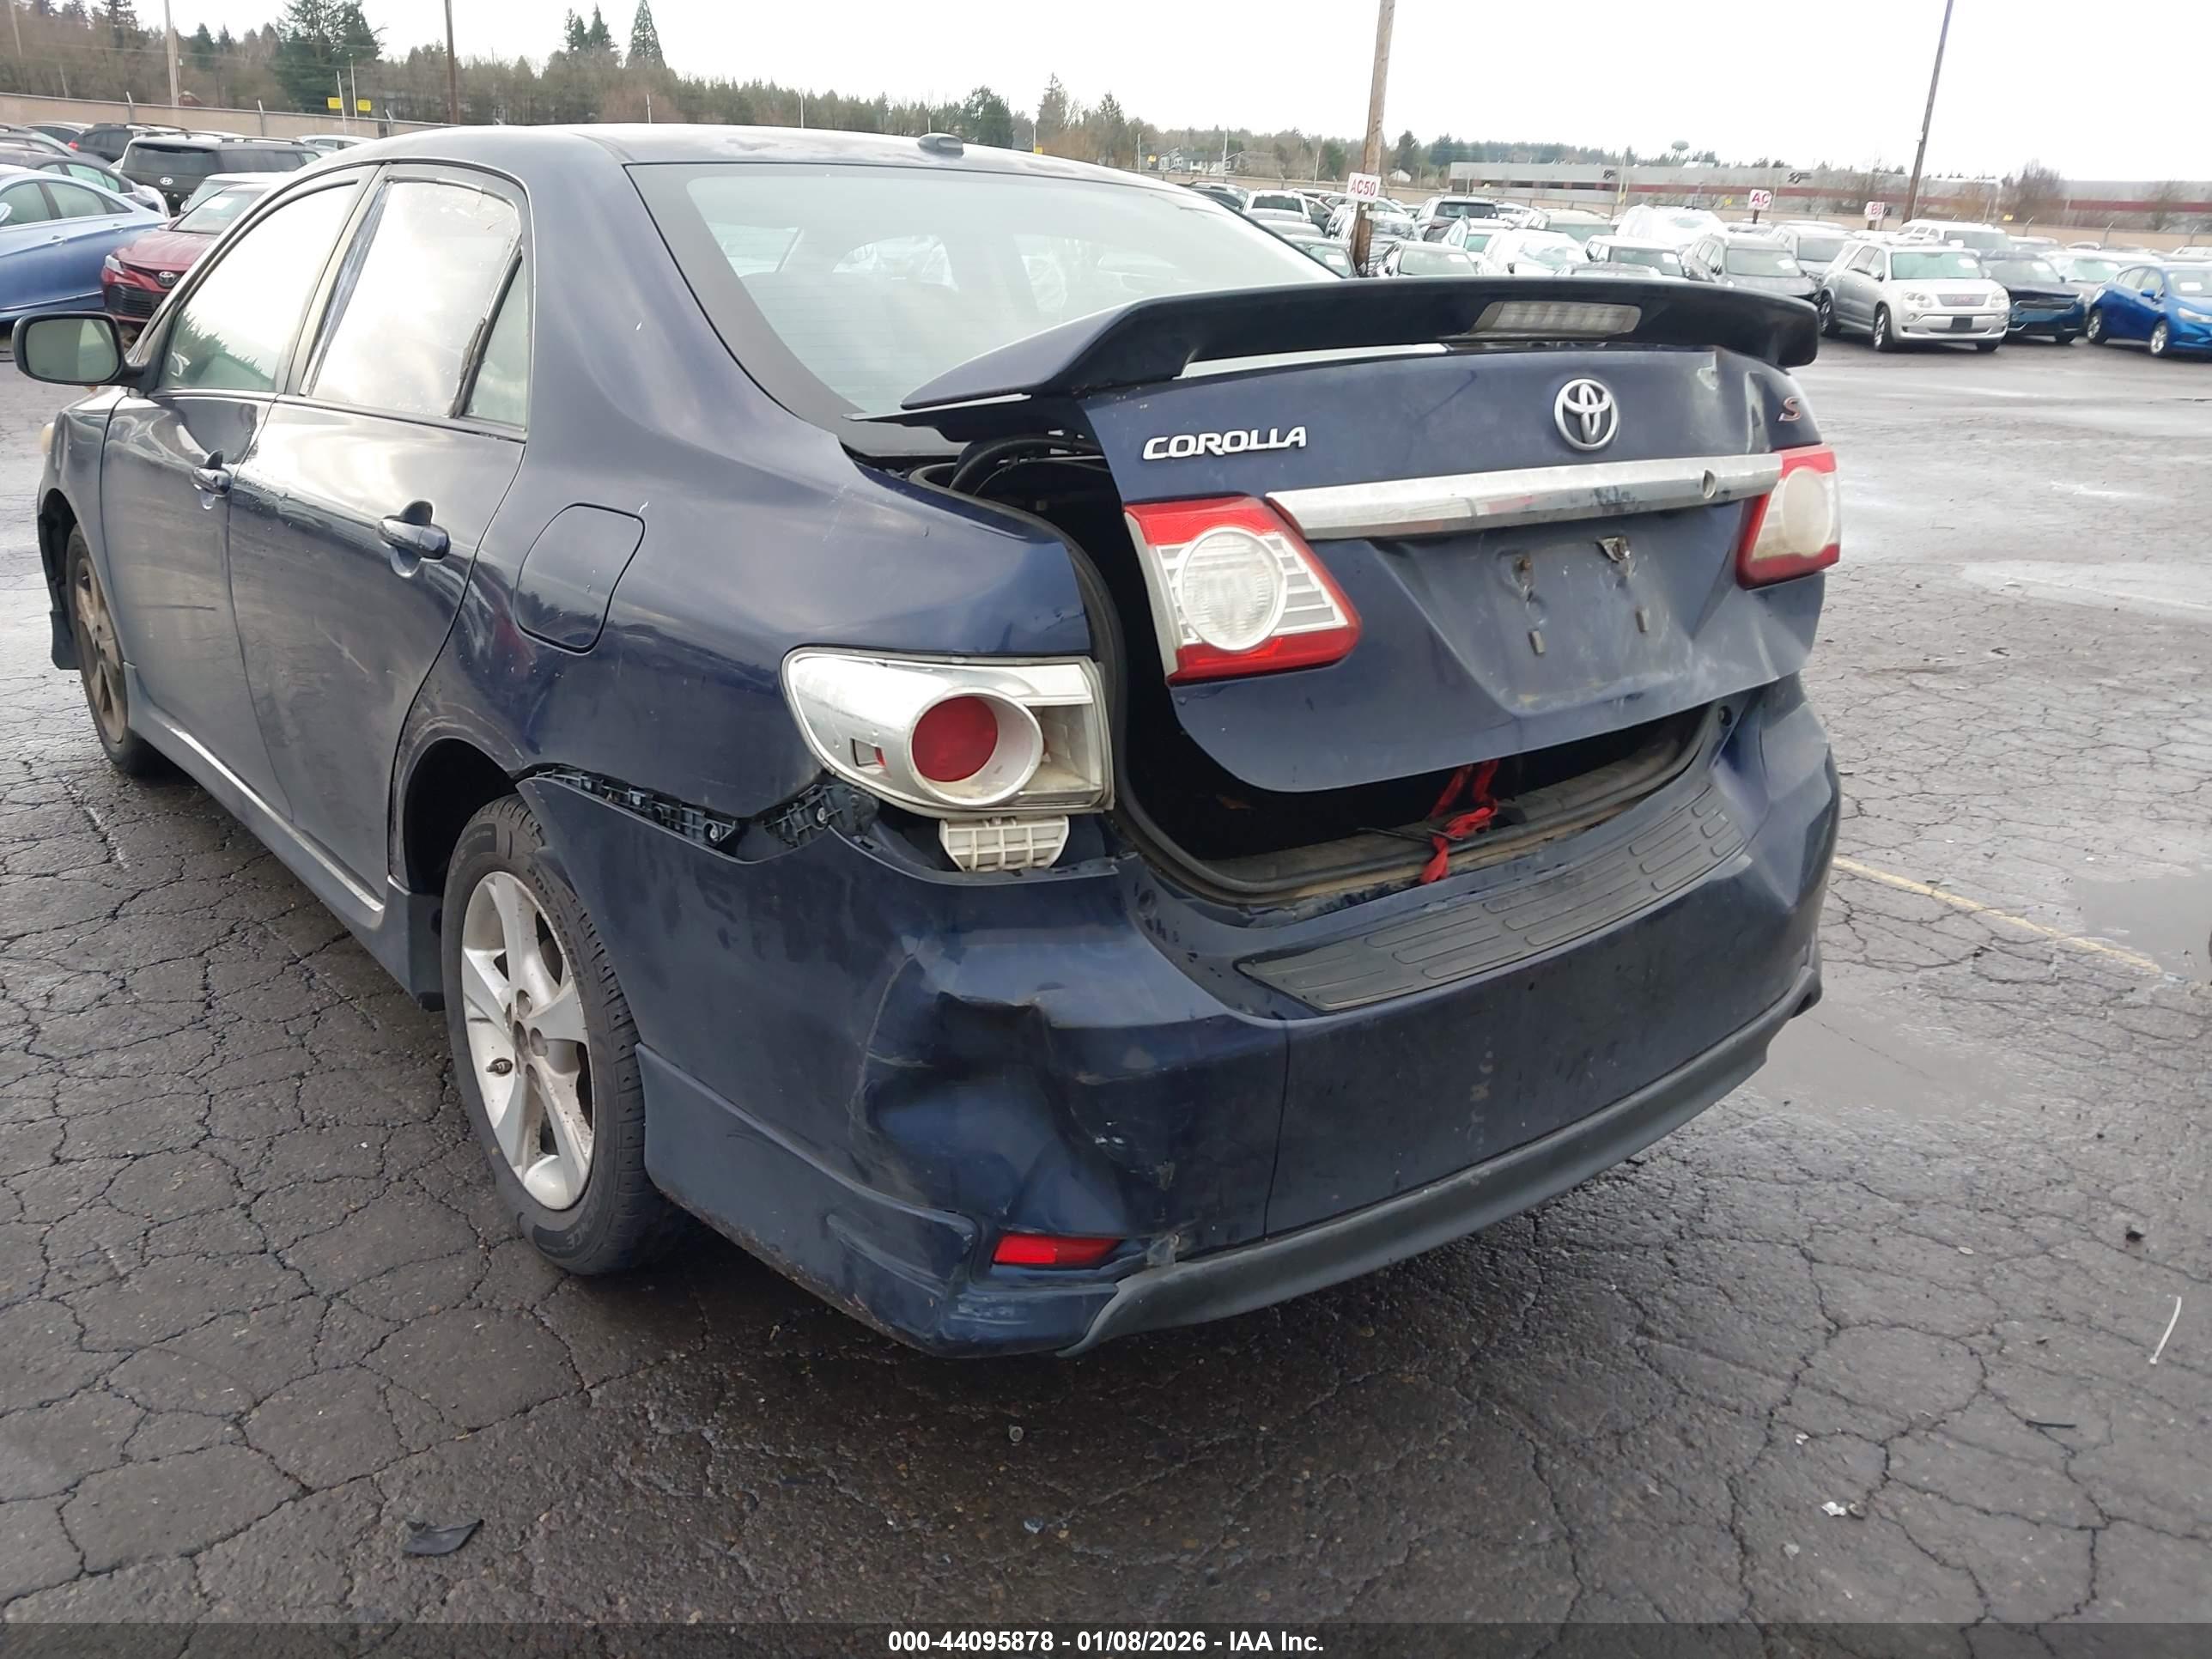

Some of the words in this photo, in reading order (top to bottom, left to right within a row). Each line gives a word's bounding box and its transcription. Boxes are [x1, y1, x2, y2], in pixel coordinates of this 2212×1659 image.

[1350, 179, 1376, 197] AC50
[1752, 192, 1771, 204] AC
[1778, 397, 1801, 422] S
[1143, 426, 1307, 460] COROLLA
